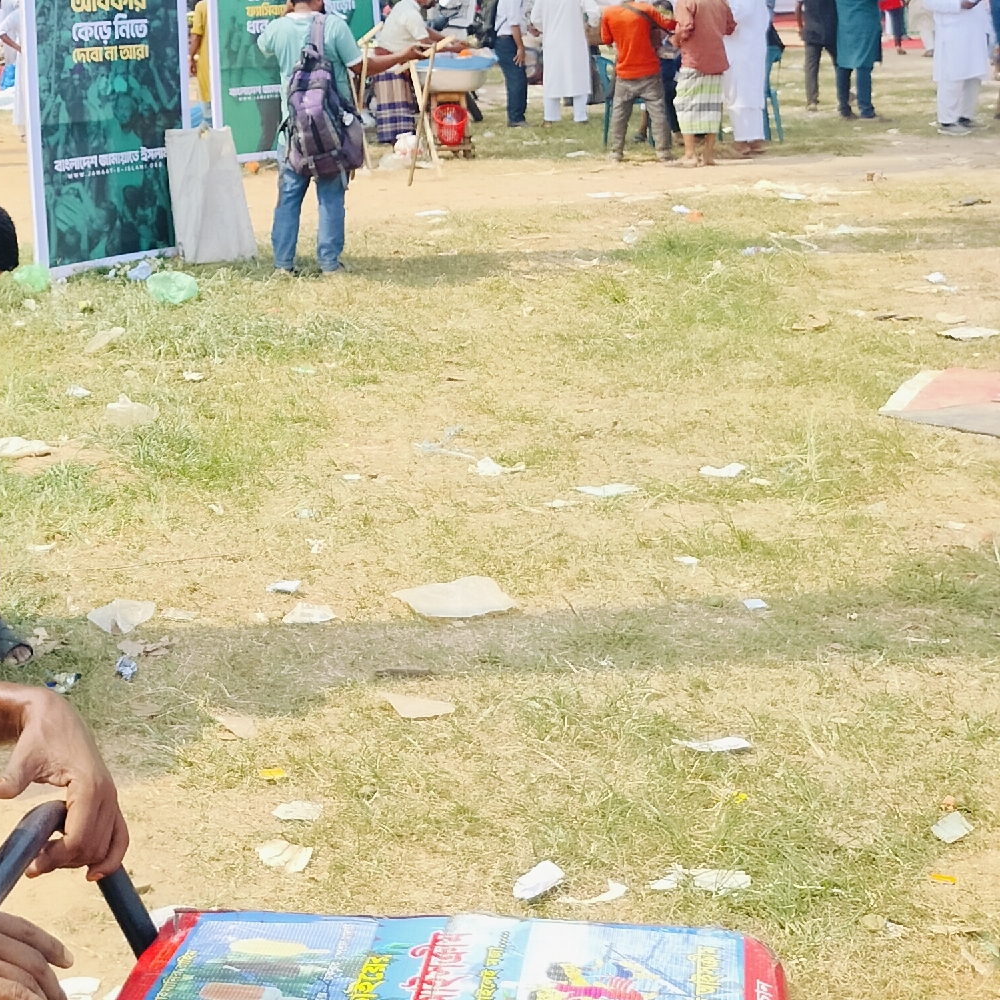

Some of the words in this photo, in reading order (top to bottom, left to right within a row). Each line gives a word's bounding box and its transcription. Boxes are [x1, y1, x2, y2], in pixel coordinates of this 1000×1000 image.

[72, 20, 112, 45] কেড়ে
[113, 13, 148, 40] নিতে
[72, 47, 103, 64] দেবো
[104, 45, 118, 61] না
